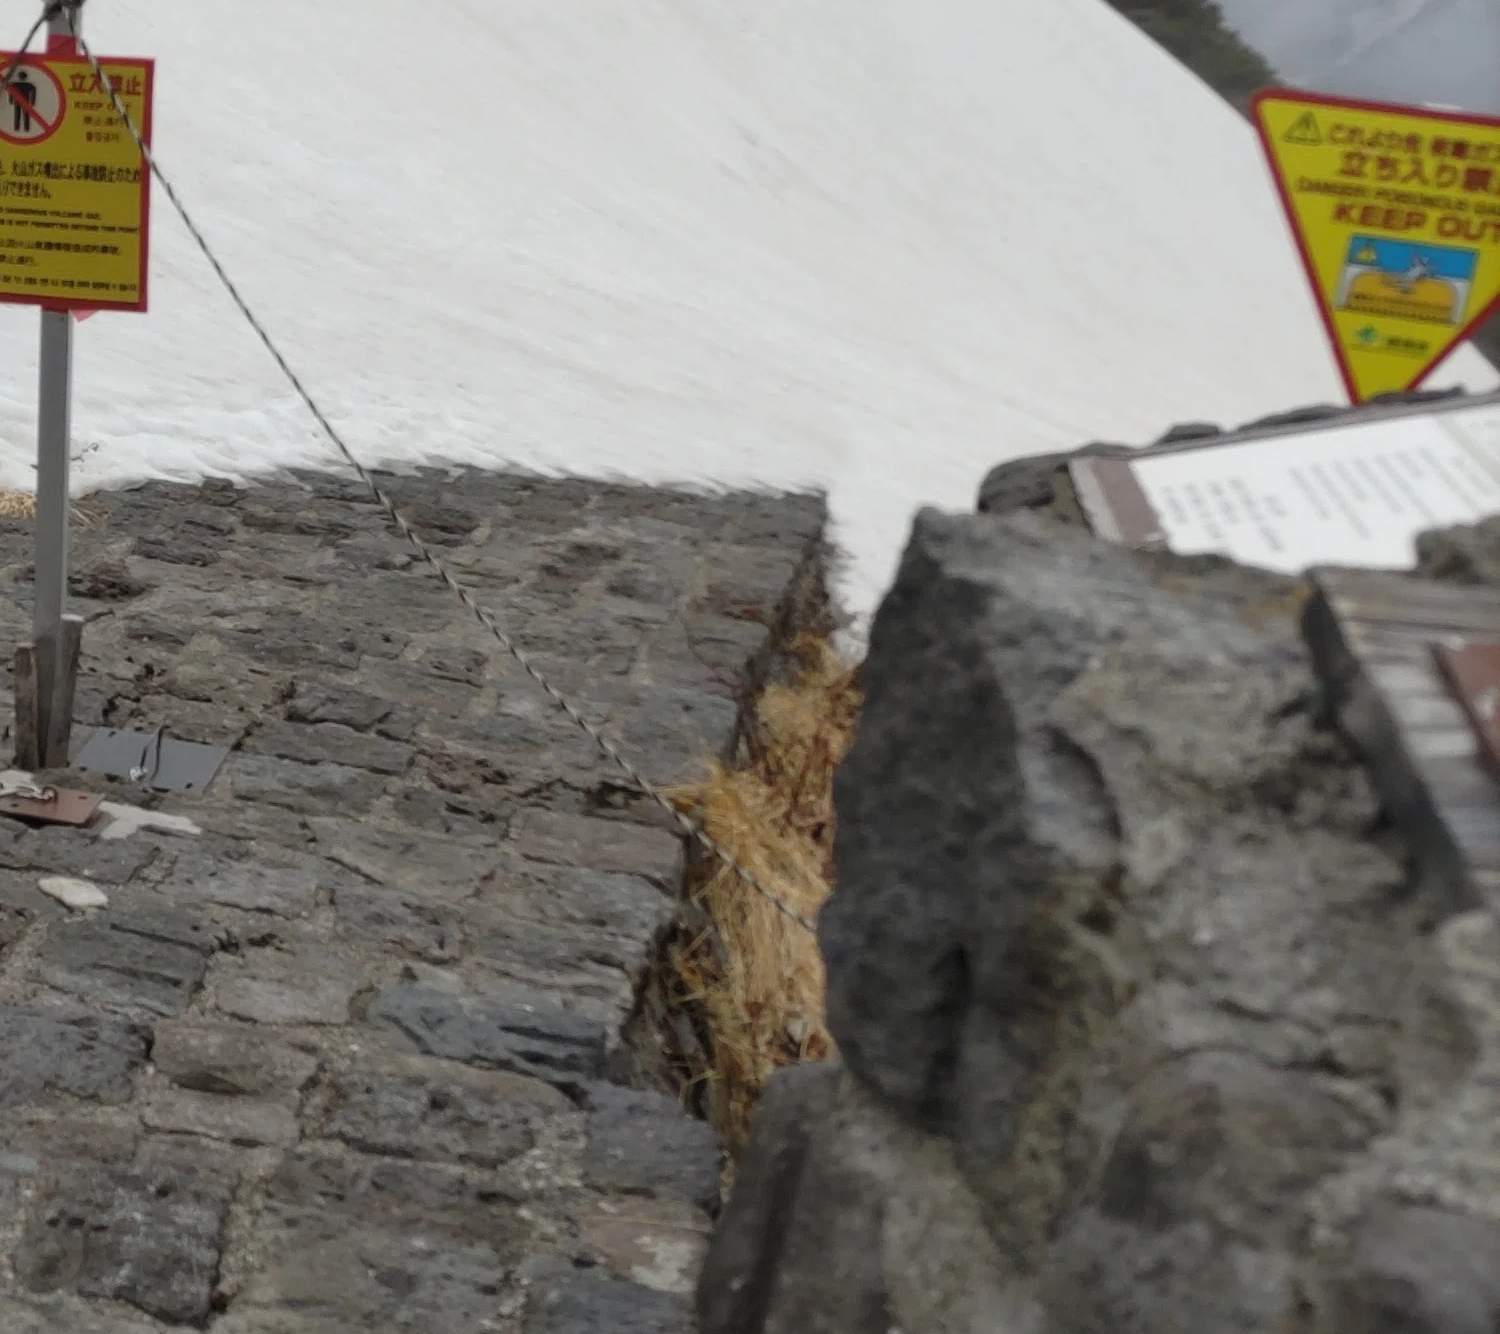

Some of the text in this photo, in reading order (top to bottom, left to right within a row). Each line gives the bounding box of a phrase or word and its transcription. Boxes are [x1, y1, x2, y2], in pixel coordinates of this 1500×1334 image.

[1337, 149, 1500, 195] 立ち入り
[1332, 202, 1427, 229] KEEP
